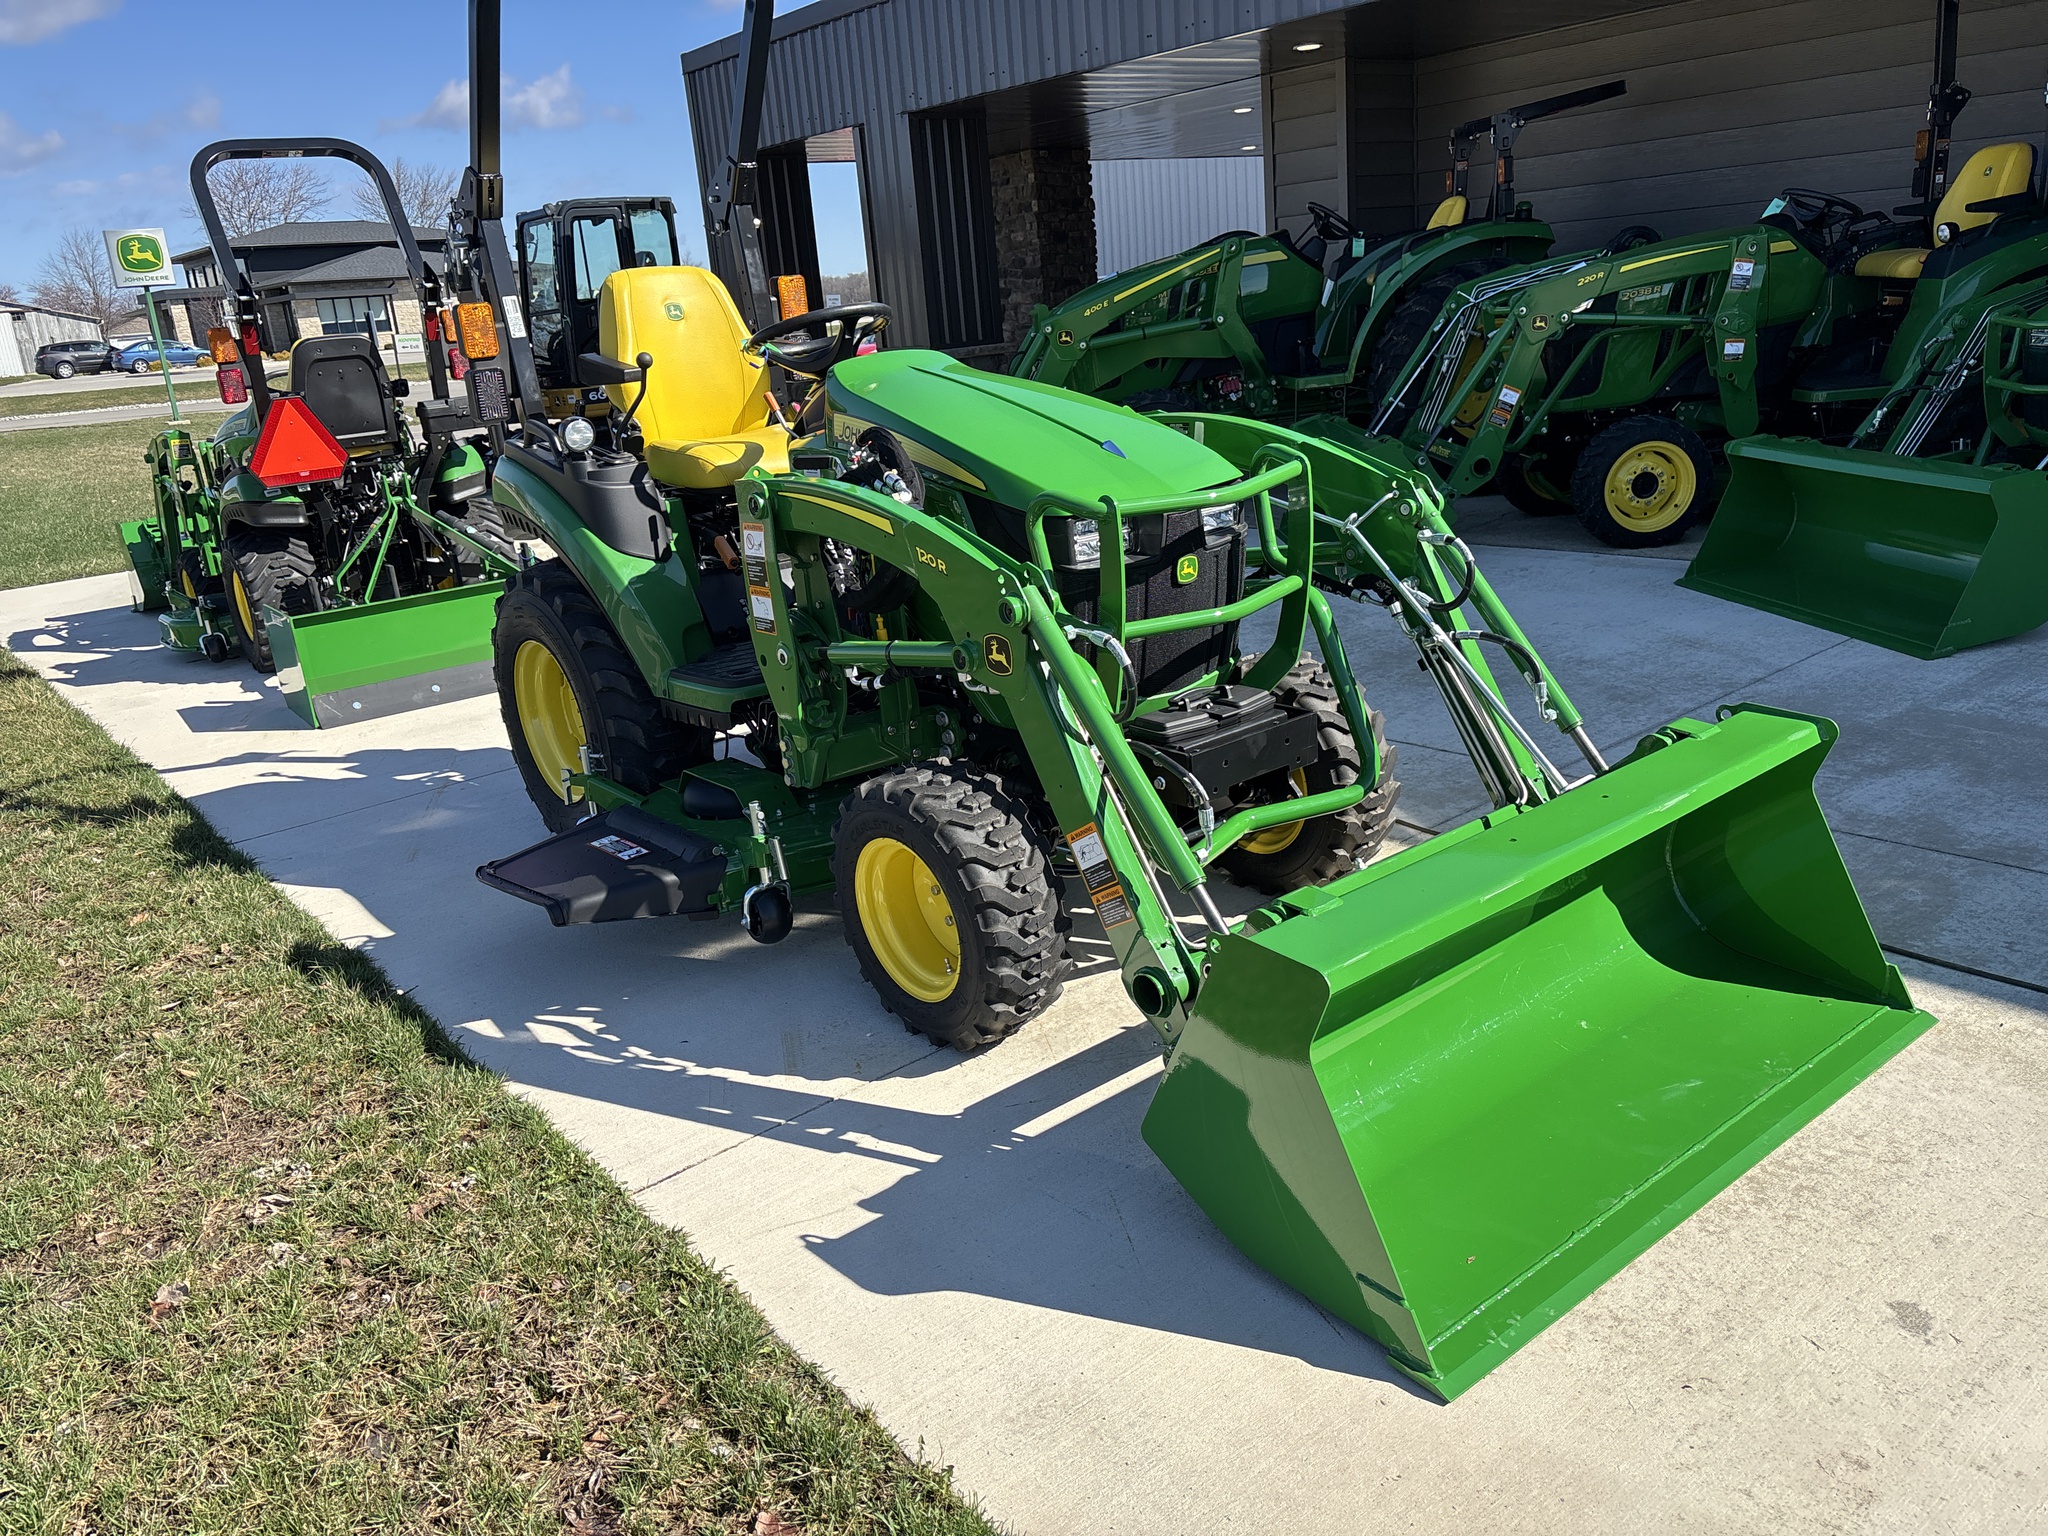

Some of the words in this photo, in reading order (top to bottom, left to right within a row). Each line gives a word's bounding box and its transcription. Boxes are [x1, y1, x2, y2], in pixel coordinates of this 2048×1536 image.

[839, 421, 864, 441] JOH
[1075, 825, 1094, 838] WARNING
[1101, 888, 1121, 900] WARNING
